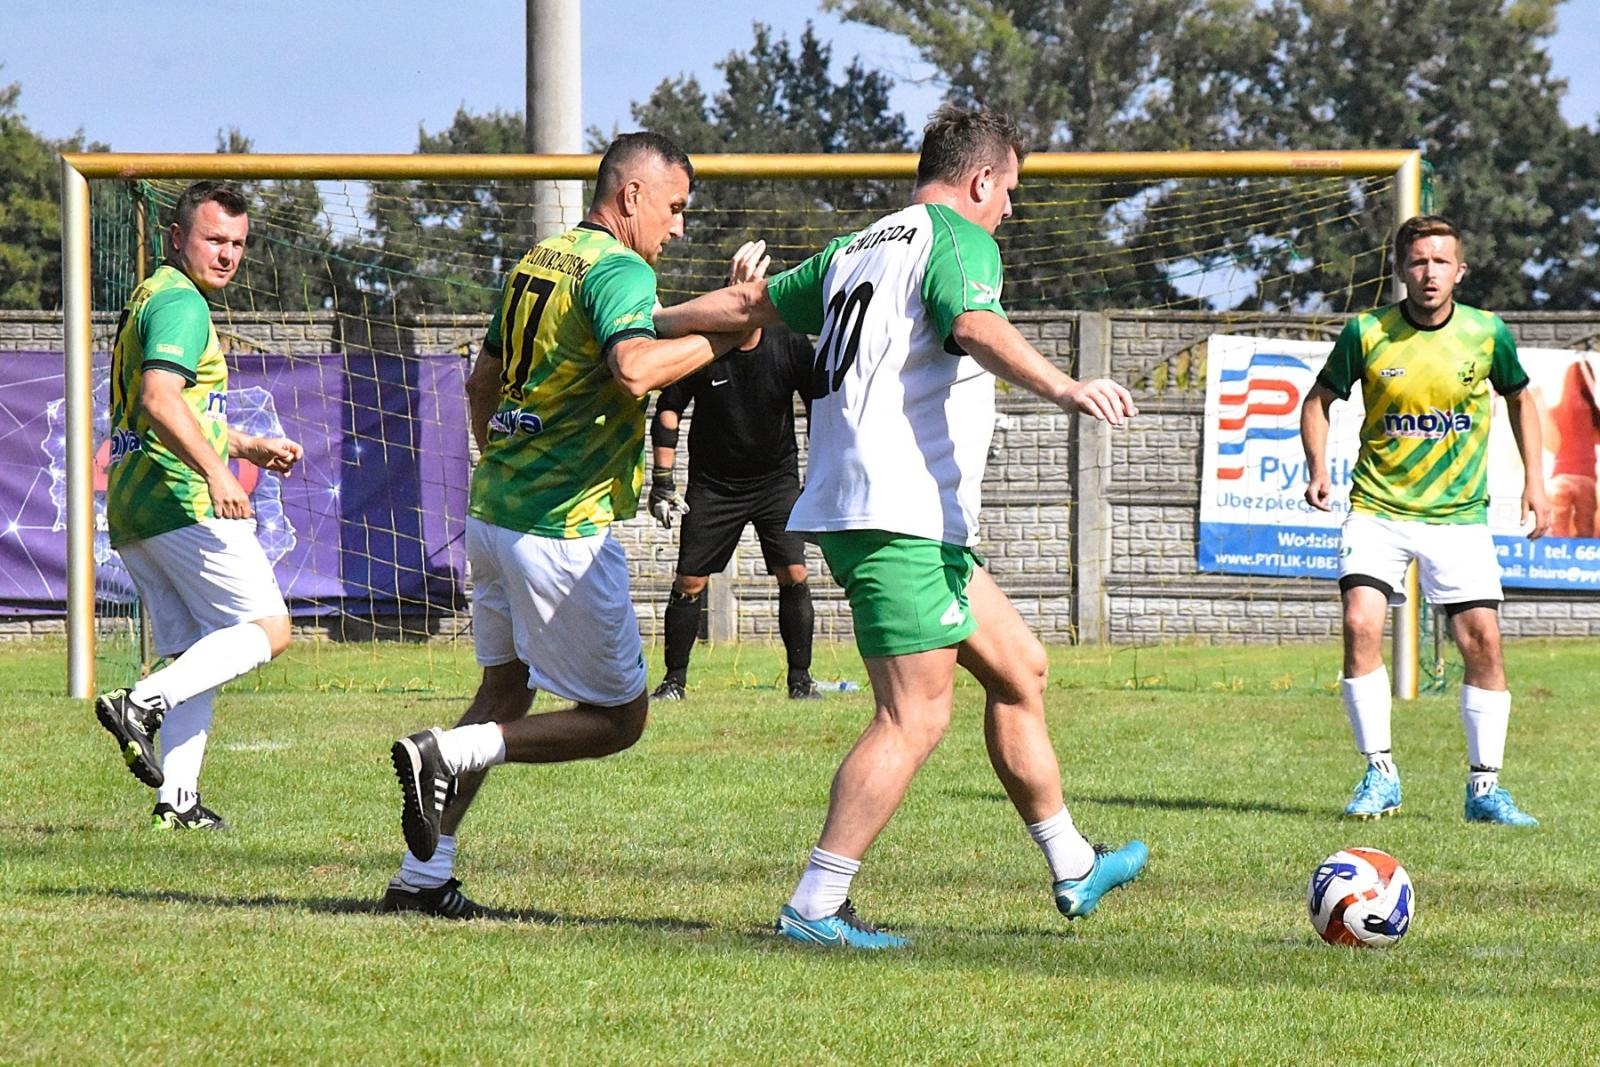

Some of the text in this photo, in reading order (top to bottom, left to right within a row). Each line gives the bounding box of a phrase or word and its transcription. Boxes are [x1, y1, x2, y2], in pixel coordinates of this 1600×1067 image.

[501, 271, 557, 402] 17
[1384, 406, 1472, 441] moya
[1215, 551, 1339, 570] www.PYTLIK-UBE
[1500, 564, 1527, 578] ail:
[1529, 564, 1600, 584] biuro@py
[1513, 543, 1524, 558] 1
[1544, 543, 1572, 561] tel.
